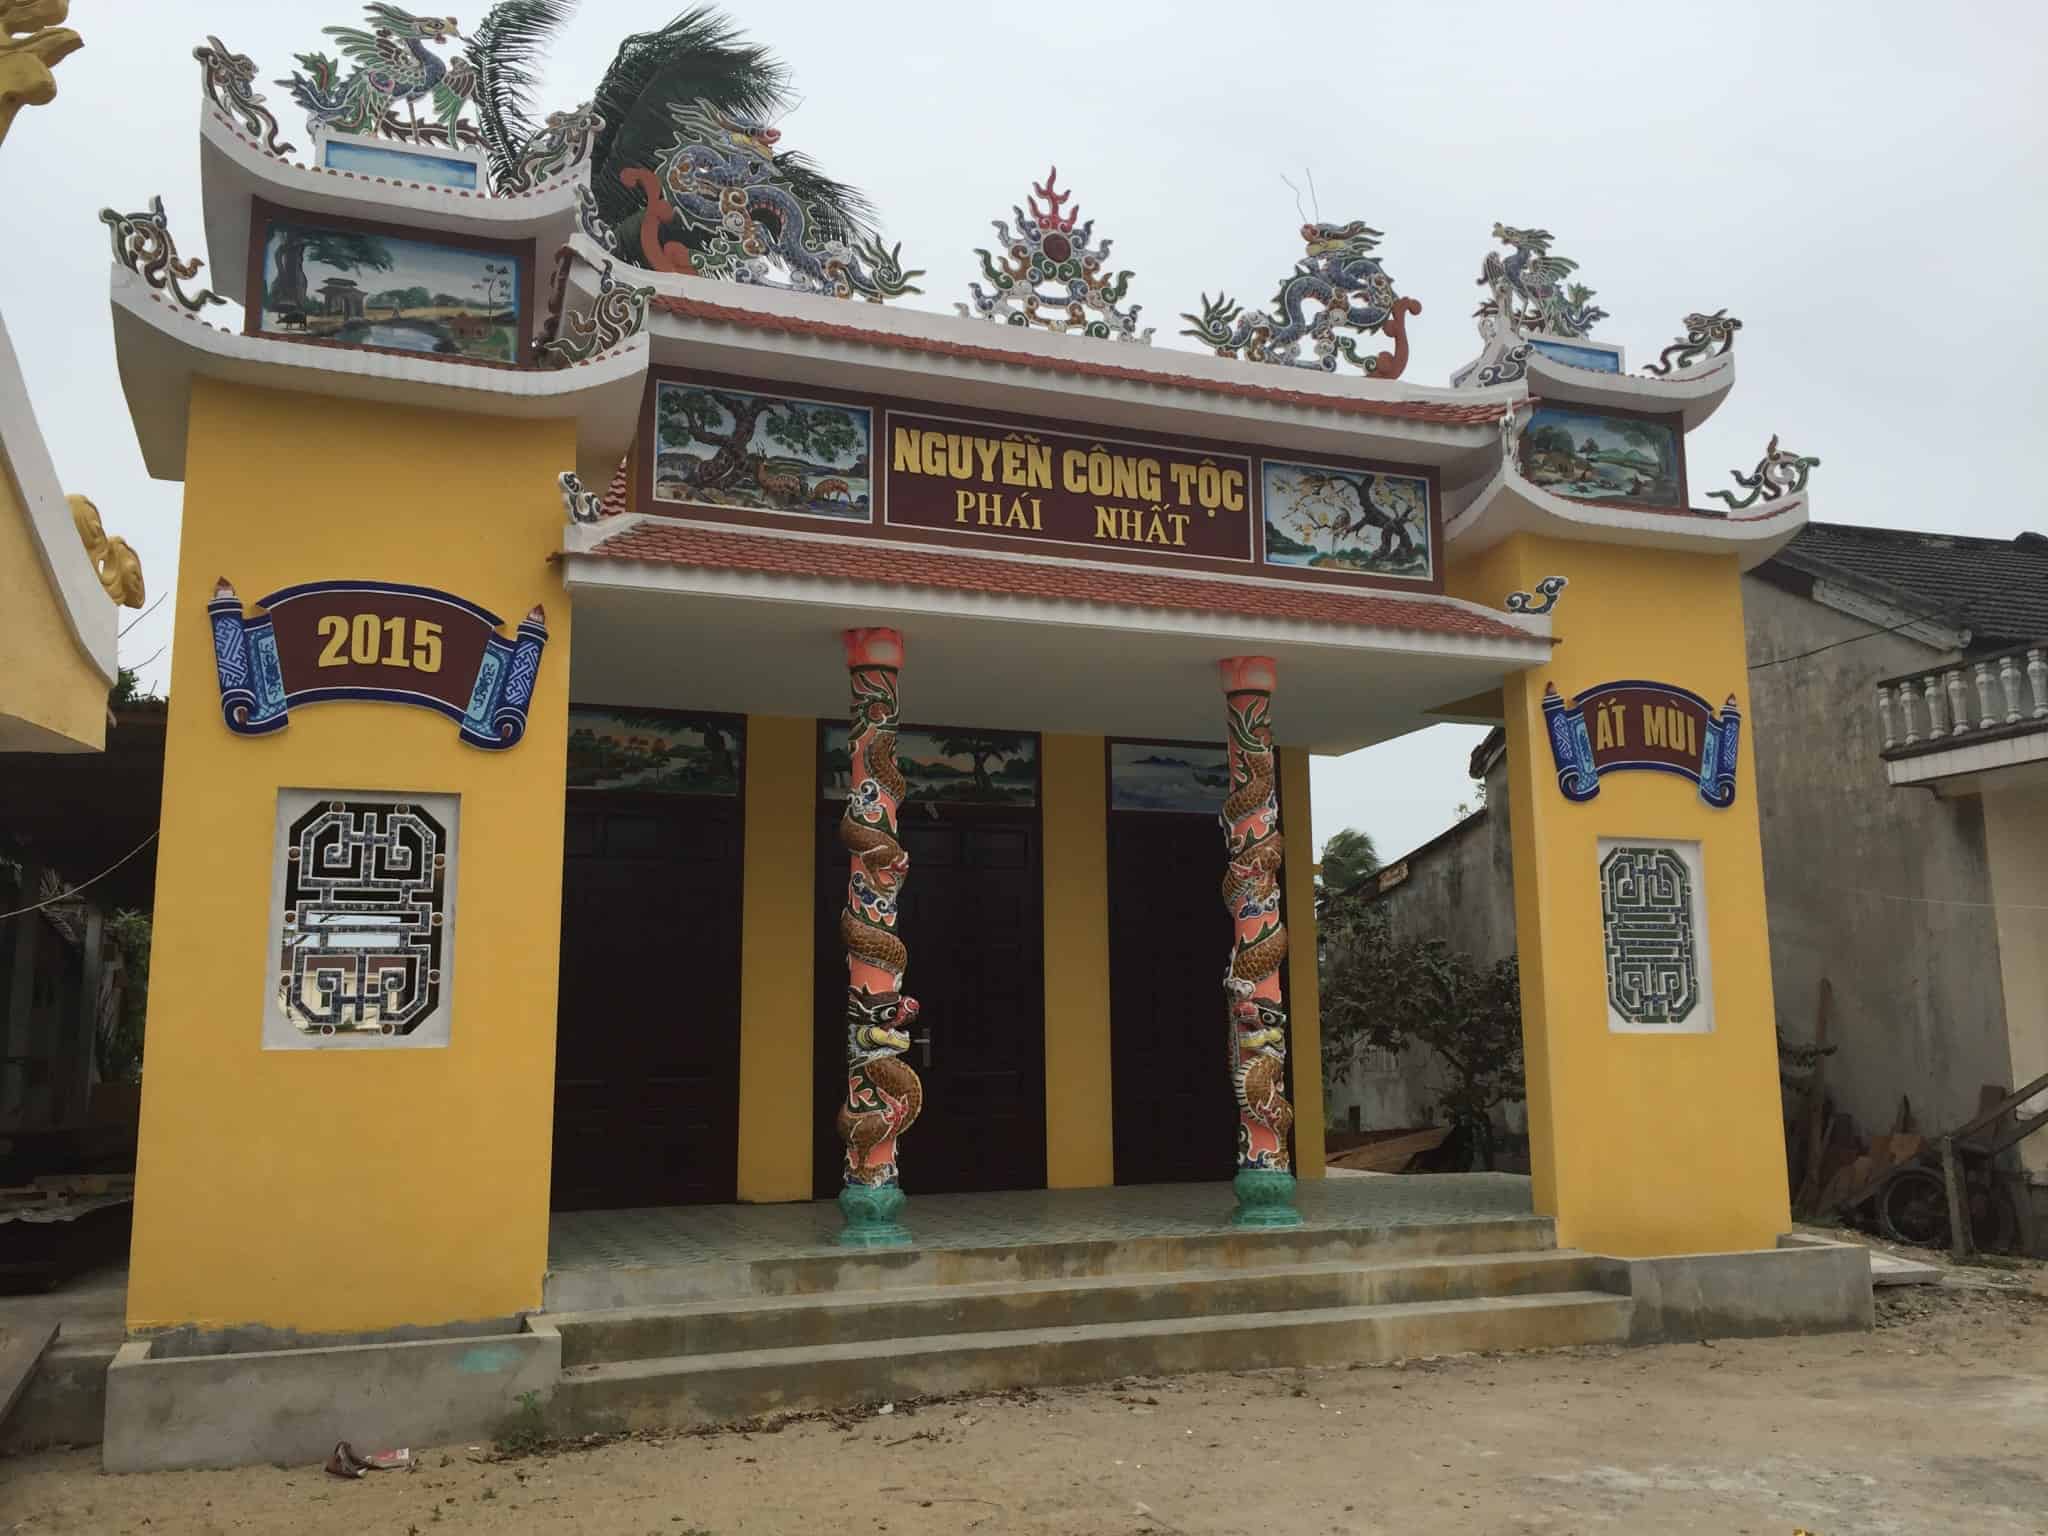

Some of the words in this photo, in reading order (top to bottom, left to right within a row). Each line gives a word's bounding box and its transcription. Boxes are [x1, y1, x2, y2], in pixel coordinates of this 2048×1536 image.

[893, 427, 1053, 490] NGUYỄN
[1062, 442, 1162, 503] CÔNG
[1169, 458, 1245, 518] TỘC
[954, 489, 1044, 531] PHÁI
[1094, 503, 1190, 547] NHẤT
[317, 614, 443, 673] 2015
[1596, 697, 1626, 752] ẤT
[1642, 699, 1697, 757] MÙI
